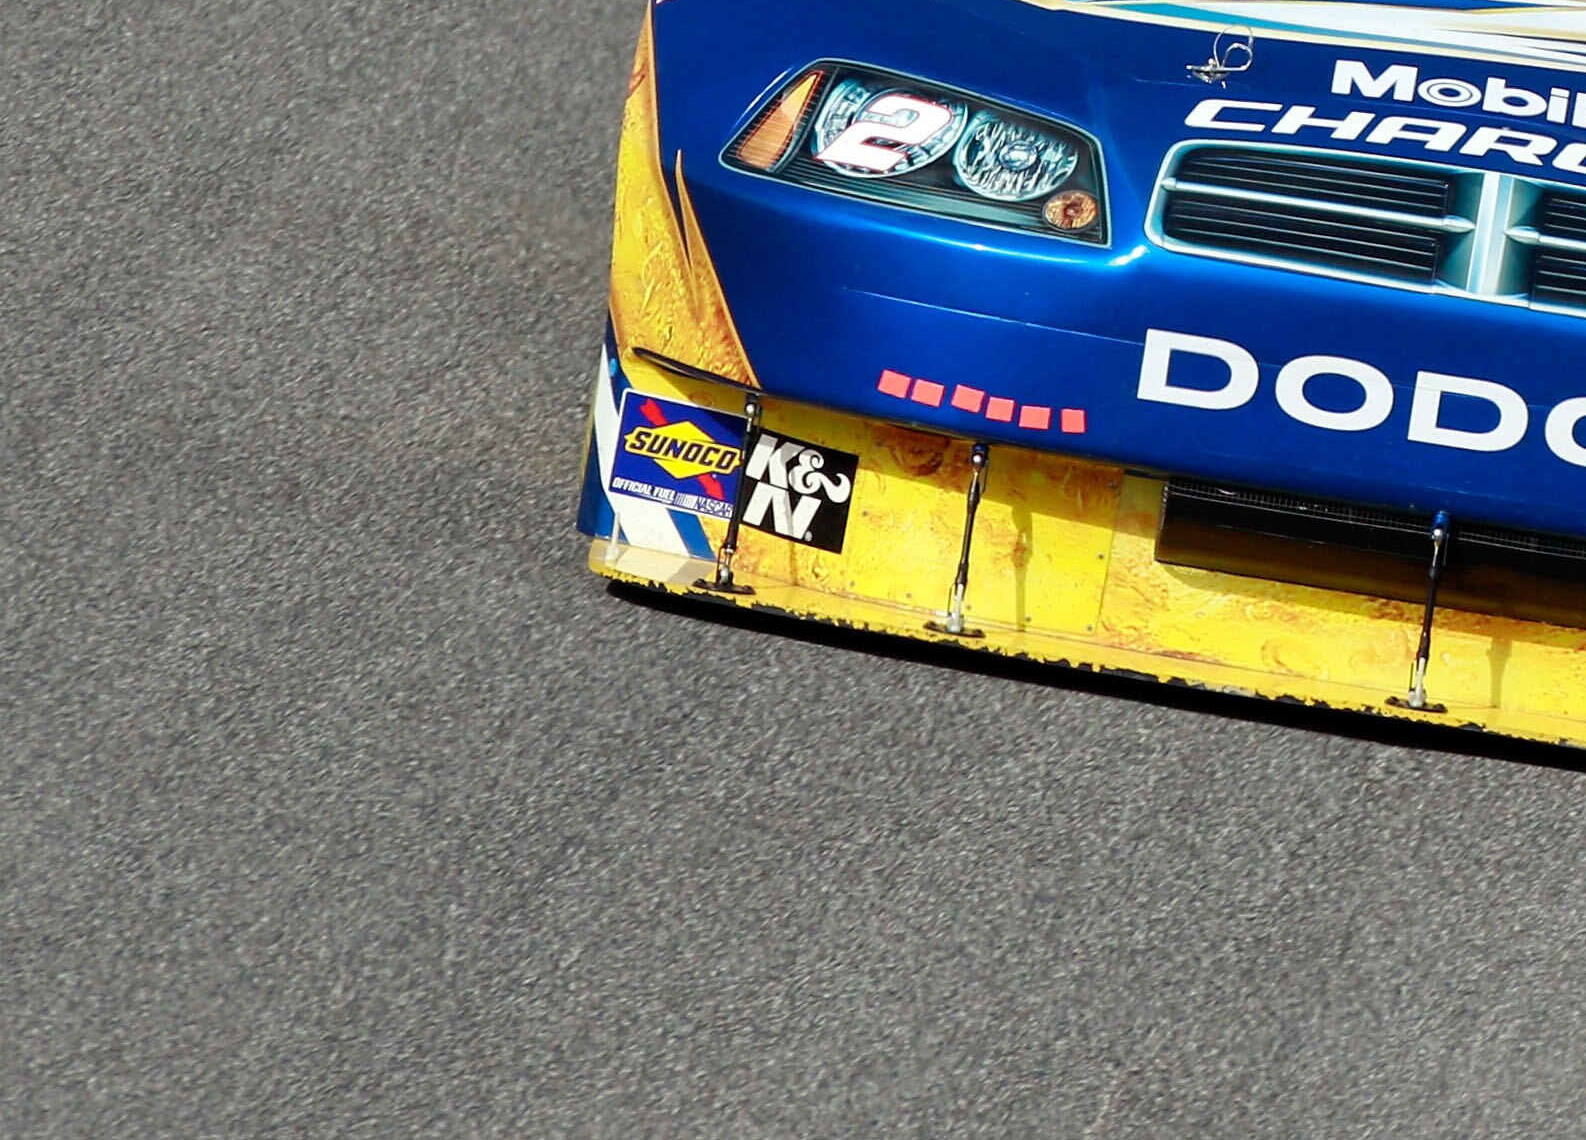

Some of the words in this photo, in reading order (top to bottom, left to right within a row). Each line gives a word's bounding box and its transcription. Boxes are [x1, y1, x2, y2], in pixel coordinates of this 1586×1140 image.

[814, 94, 955, 174] 2
[629, 431, 739, 470] SUNOCO
[612, 477, 652, 495] OFFICIAL
[653, 486, 676, 501] FUEL
